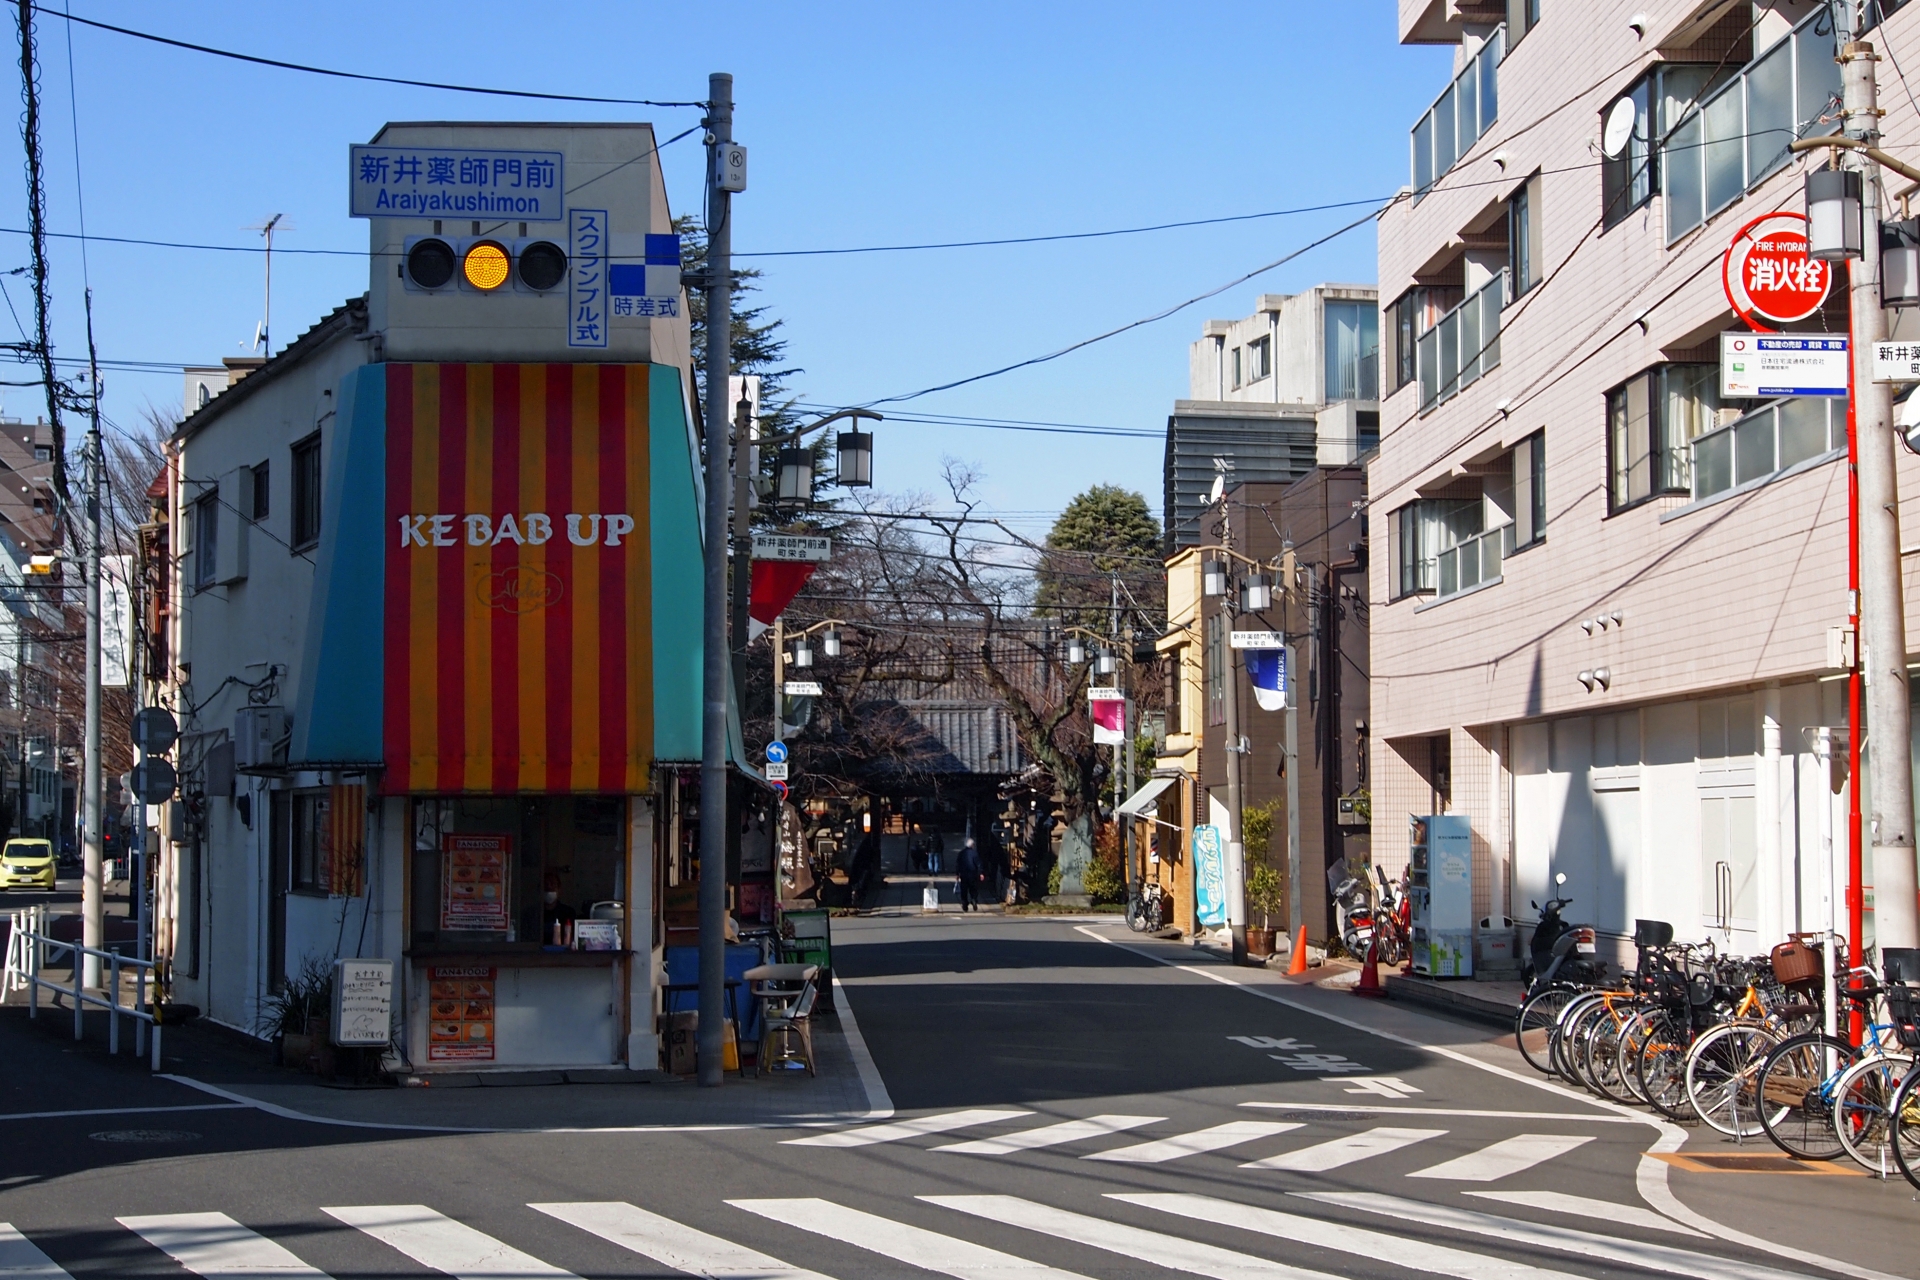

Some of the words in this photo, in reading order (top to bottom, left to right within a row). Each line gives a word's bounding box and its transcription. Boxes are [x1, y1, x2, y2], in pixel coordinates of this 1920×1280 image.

[360, 154, 556, 189] 新井薬師門前
[376, 188, 540, 215] Araiyakushimon
[1756, 241, 1774, 252] FIRE
[576, 215, 600, 342] スクランブル式
[1749, 257, 1823, 293] 消火栓
[613, 296, 677, 317] 時差式
[398, 512, 553, 548] KEBAB
[564, 513, 635, 546] UP
[757, 537, 827, 550] 新井薬師門前通
[777, 548, 807, 558] 町栄会
